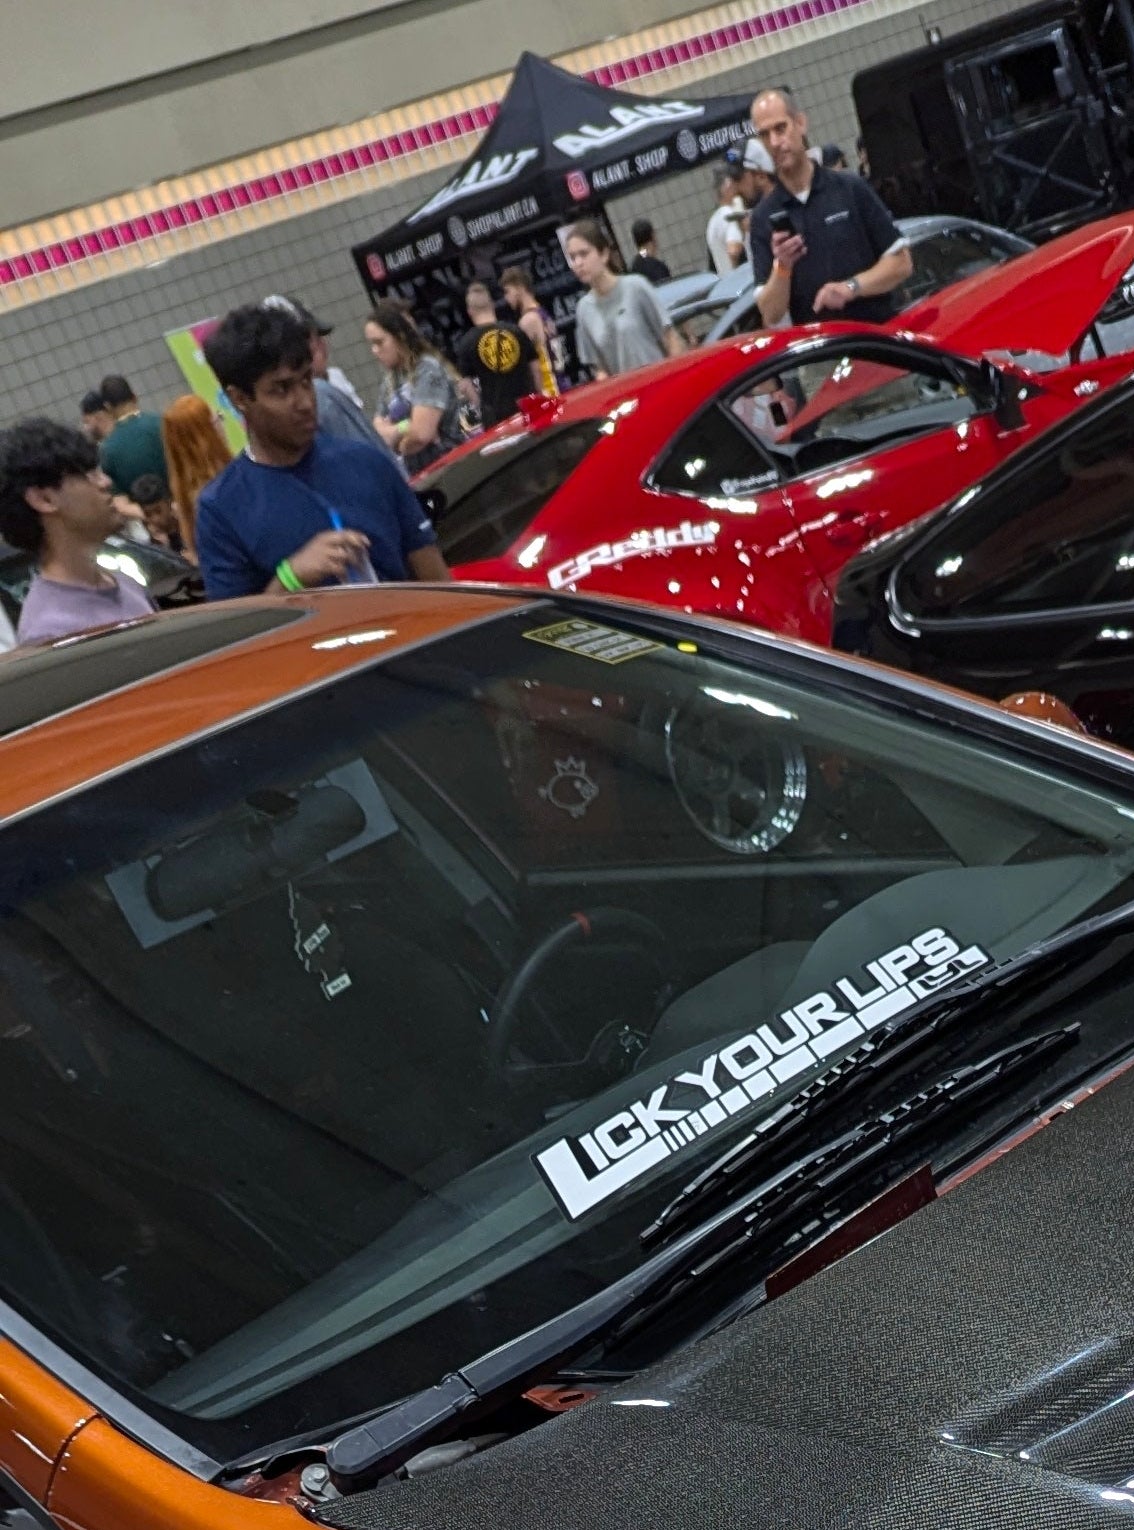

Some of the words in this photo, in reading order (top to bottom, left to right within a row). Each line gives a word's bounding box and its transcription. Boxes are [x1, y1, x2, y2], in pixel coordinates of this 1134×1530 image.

[553, 101, 706, 158] ALANT
[537, 1084, 692, 1220] LICK
[680, 991, 852, 1098] YOUR
[836, 927, 960, 1011] LIPS
